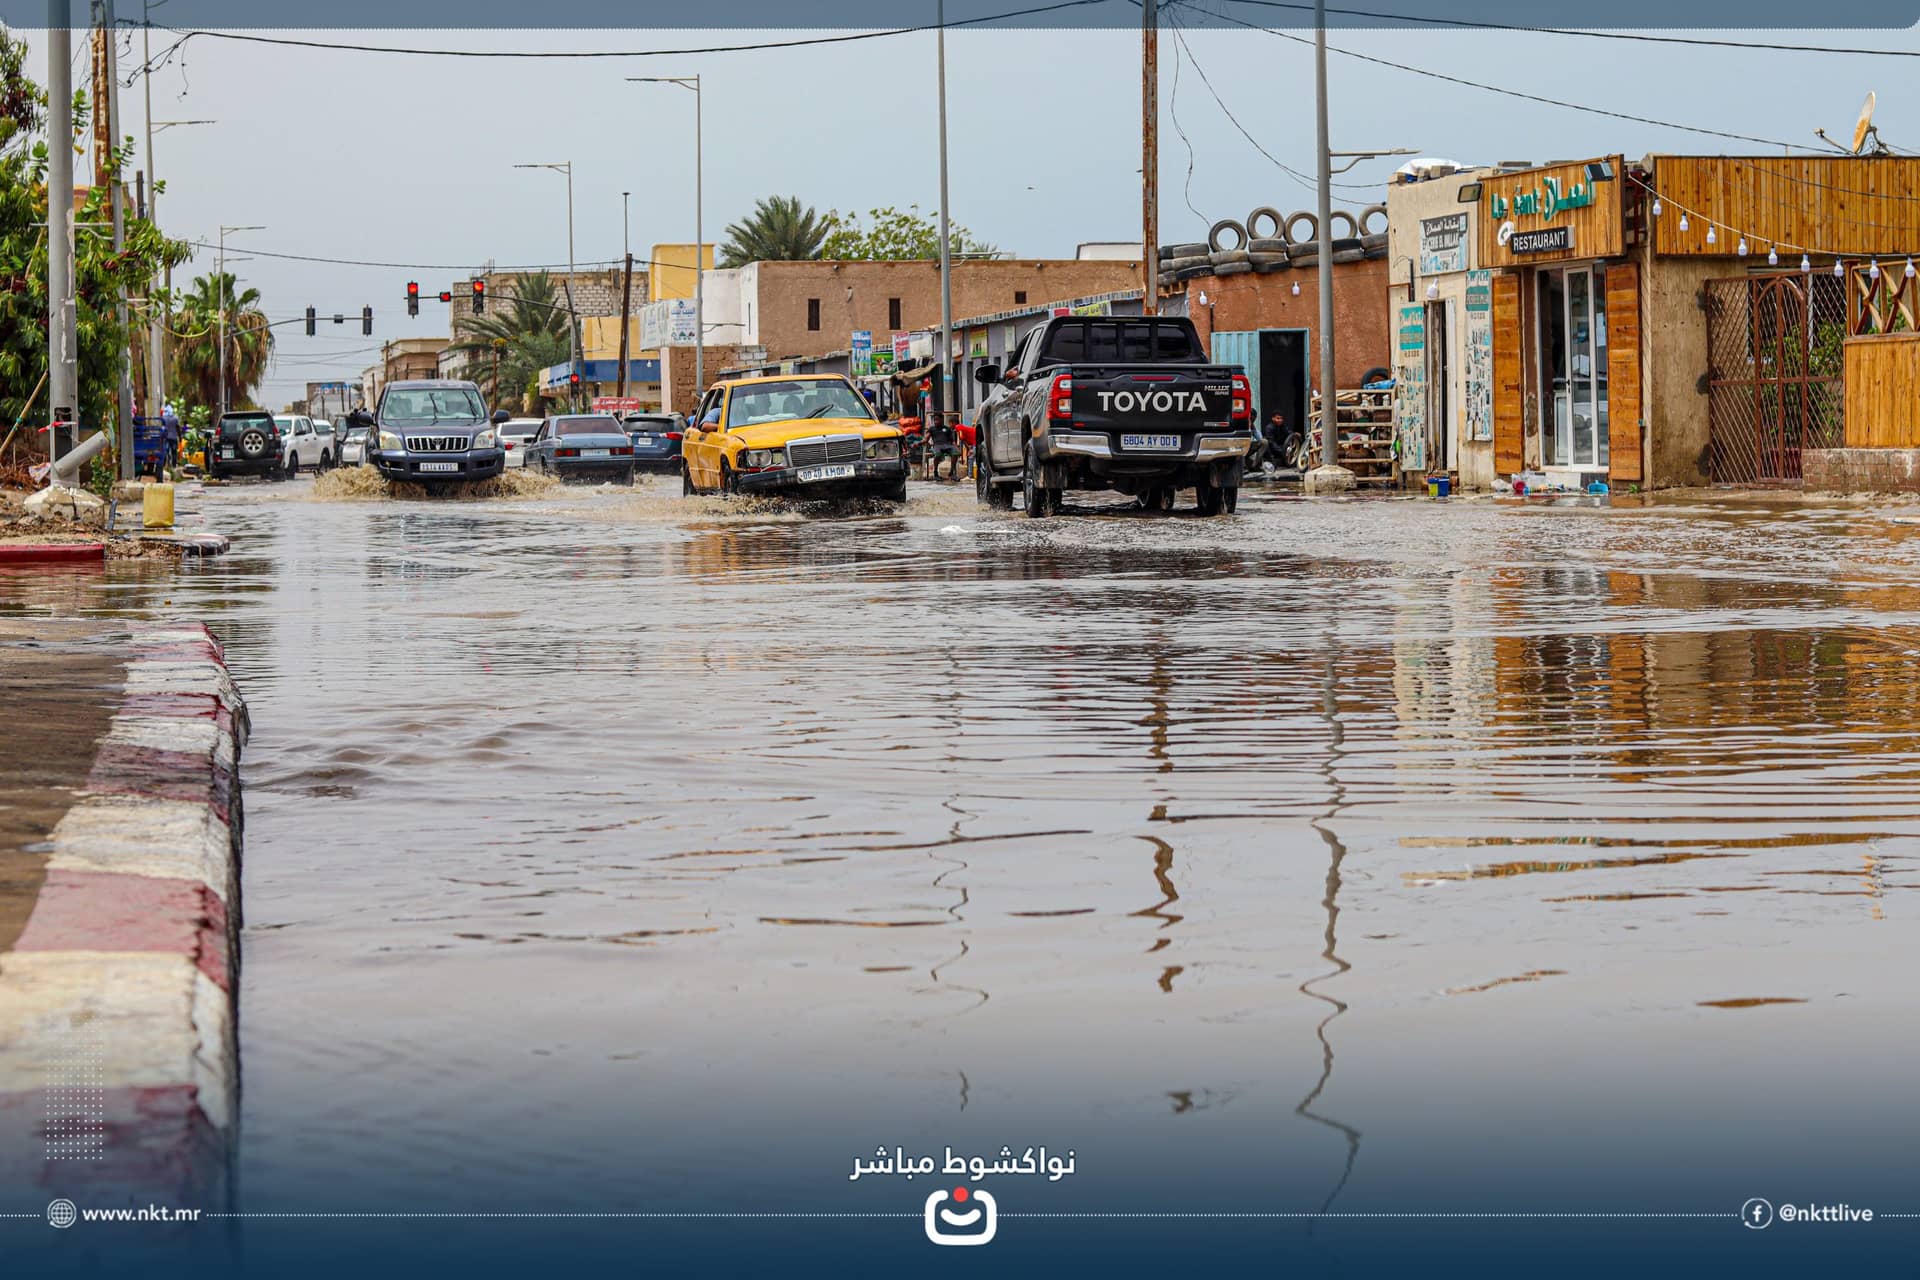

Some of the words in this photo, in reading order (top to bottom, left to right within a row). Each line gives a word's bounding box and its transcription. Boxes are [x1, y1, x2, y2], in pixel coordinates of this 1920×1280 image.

[1513, 230, 1565, 251] RESTAURANT
[1097, 391, 1207, 412] TOYOTA
[1123, 436, 1144, 446] 6804
[1147, 436, 1157, 446] AY
